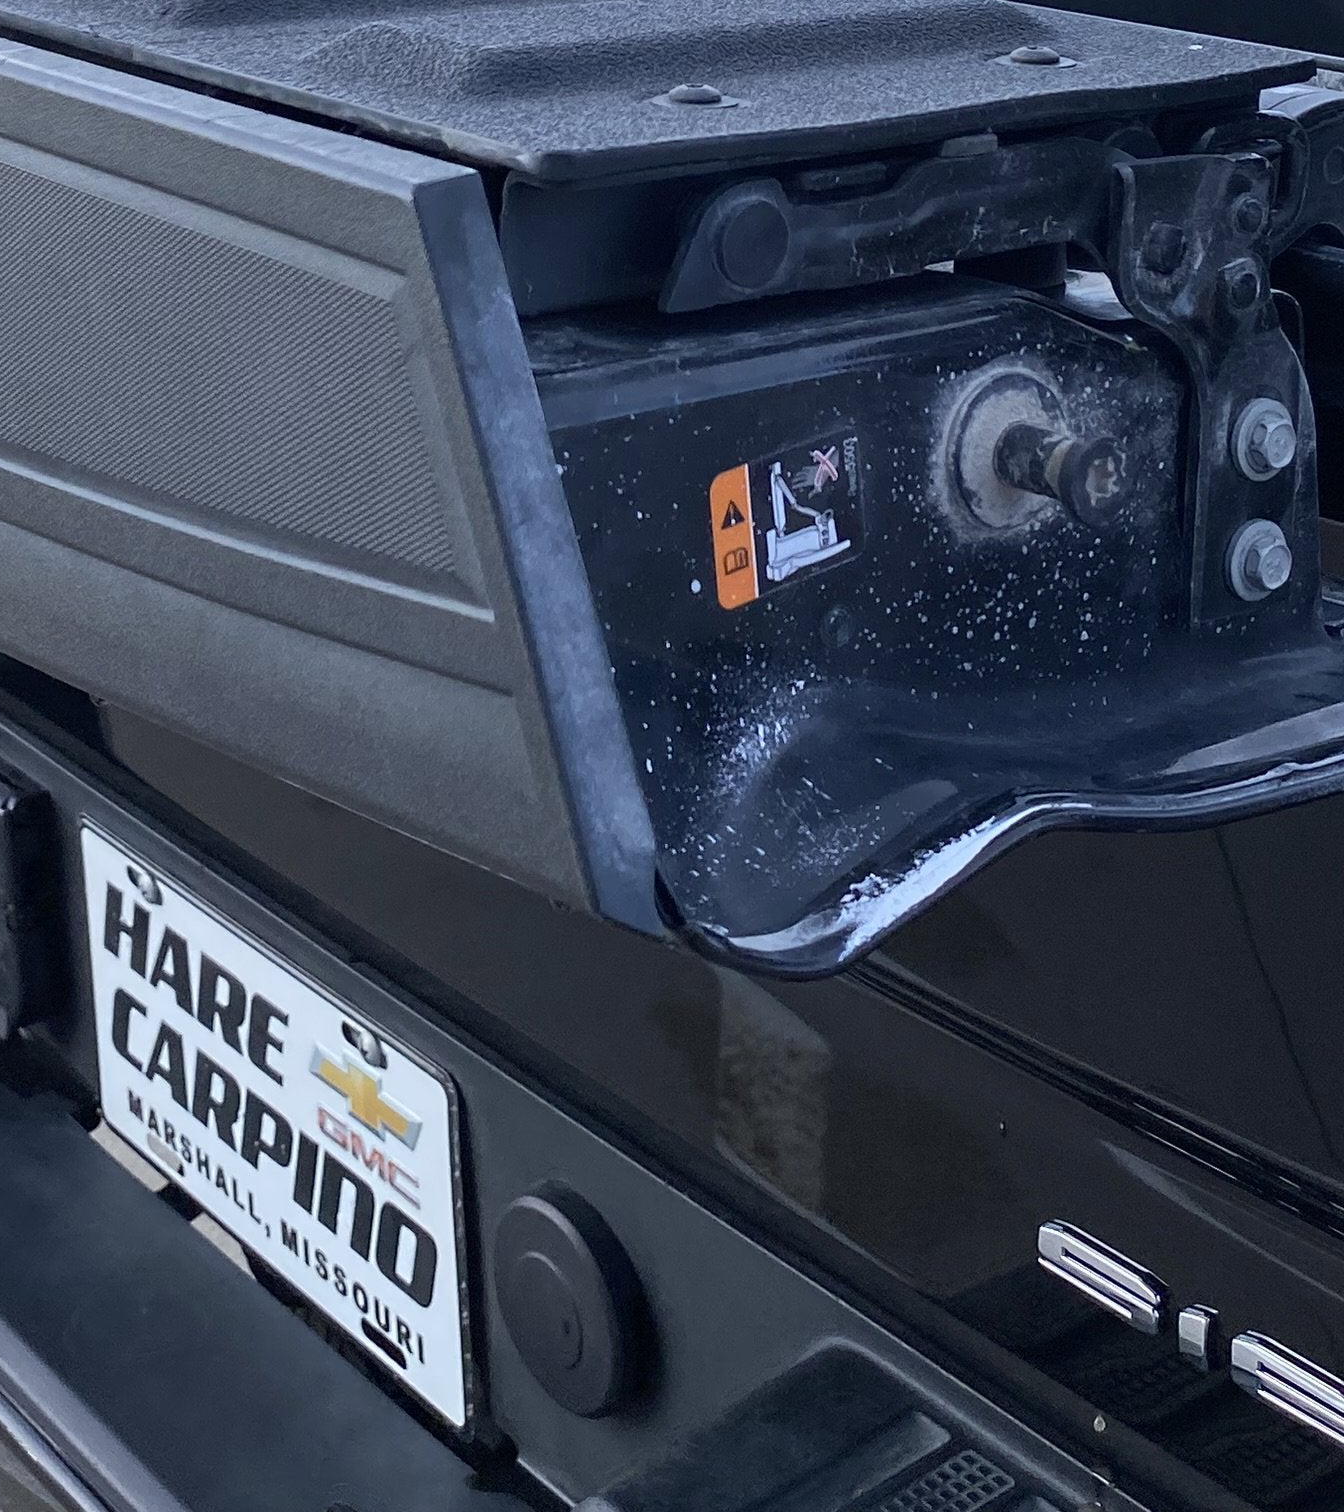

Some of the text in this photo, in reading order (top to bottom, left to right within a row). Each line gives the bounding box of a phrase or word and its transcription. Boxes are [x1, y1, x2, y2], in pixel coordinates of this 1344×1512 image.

[103, 882, 289, 1087] HARE
[112, 987, 439, 1309] CARPINO
[127, 1090, 427, 1365] MARSHALL, MISSOURI
[316, 1106, 421, 1211] GMC
